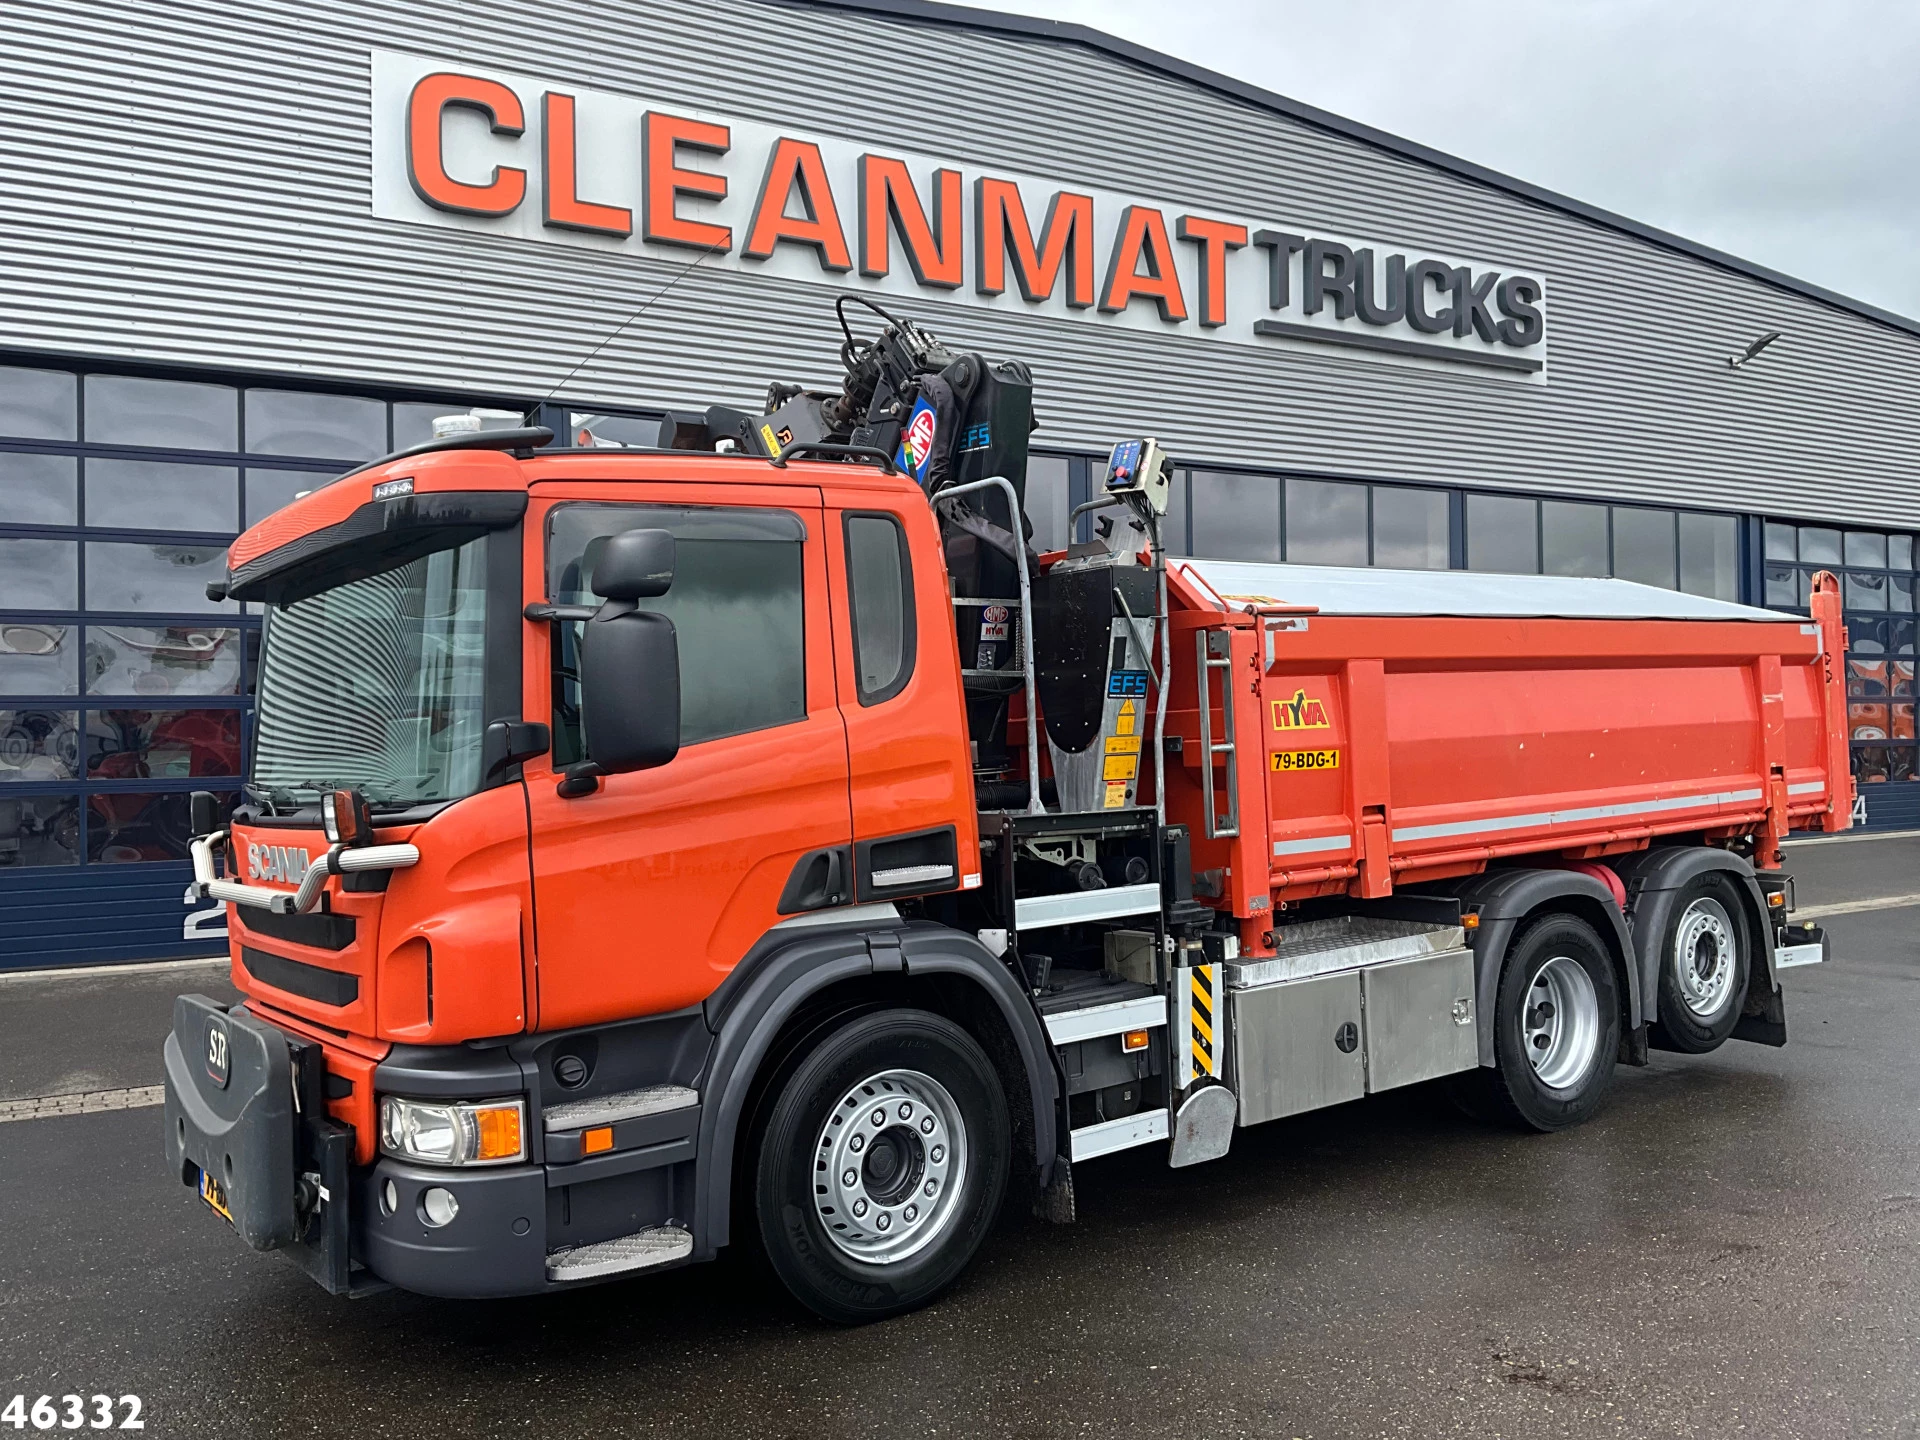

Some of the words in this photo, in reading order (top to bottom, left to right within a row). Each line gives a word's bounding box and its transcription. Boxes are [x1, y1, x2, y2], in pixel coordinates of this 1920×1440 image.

[405, 72, 1248, 327] CLEANMAT
[1253, 229, 1543, 347] TRUCKS
[985, 607, 1006, 622] HMF
[985, 624, 1004, 635] HYVA
[1109, 675, 1147, 693] EFS
[1273, 692, 1328, 727] HYVA
[1274, 751, 1337, 770] 79-BDG-1
[1852, 795, 1868, 825] 4
[248, 843, 310, 885] SCANIA
[183, 886, 229, 940] 2
[208, 1027, 227, 1070] SR
